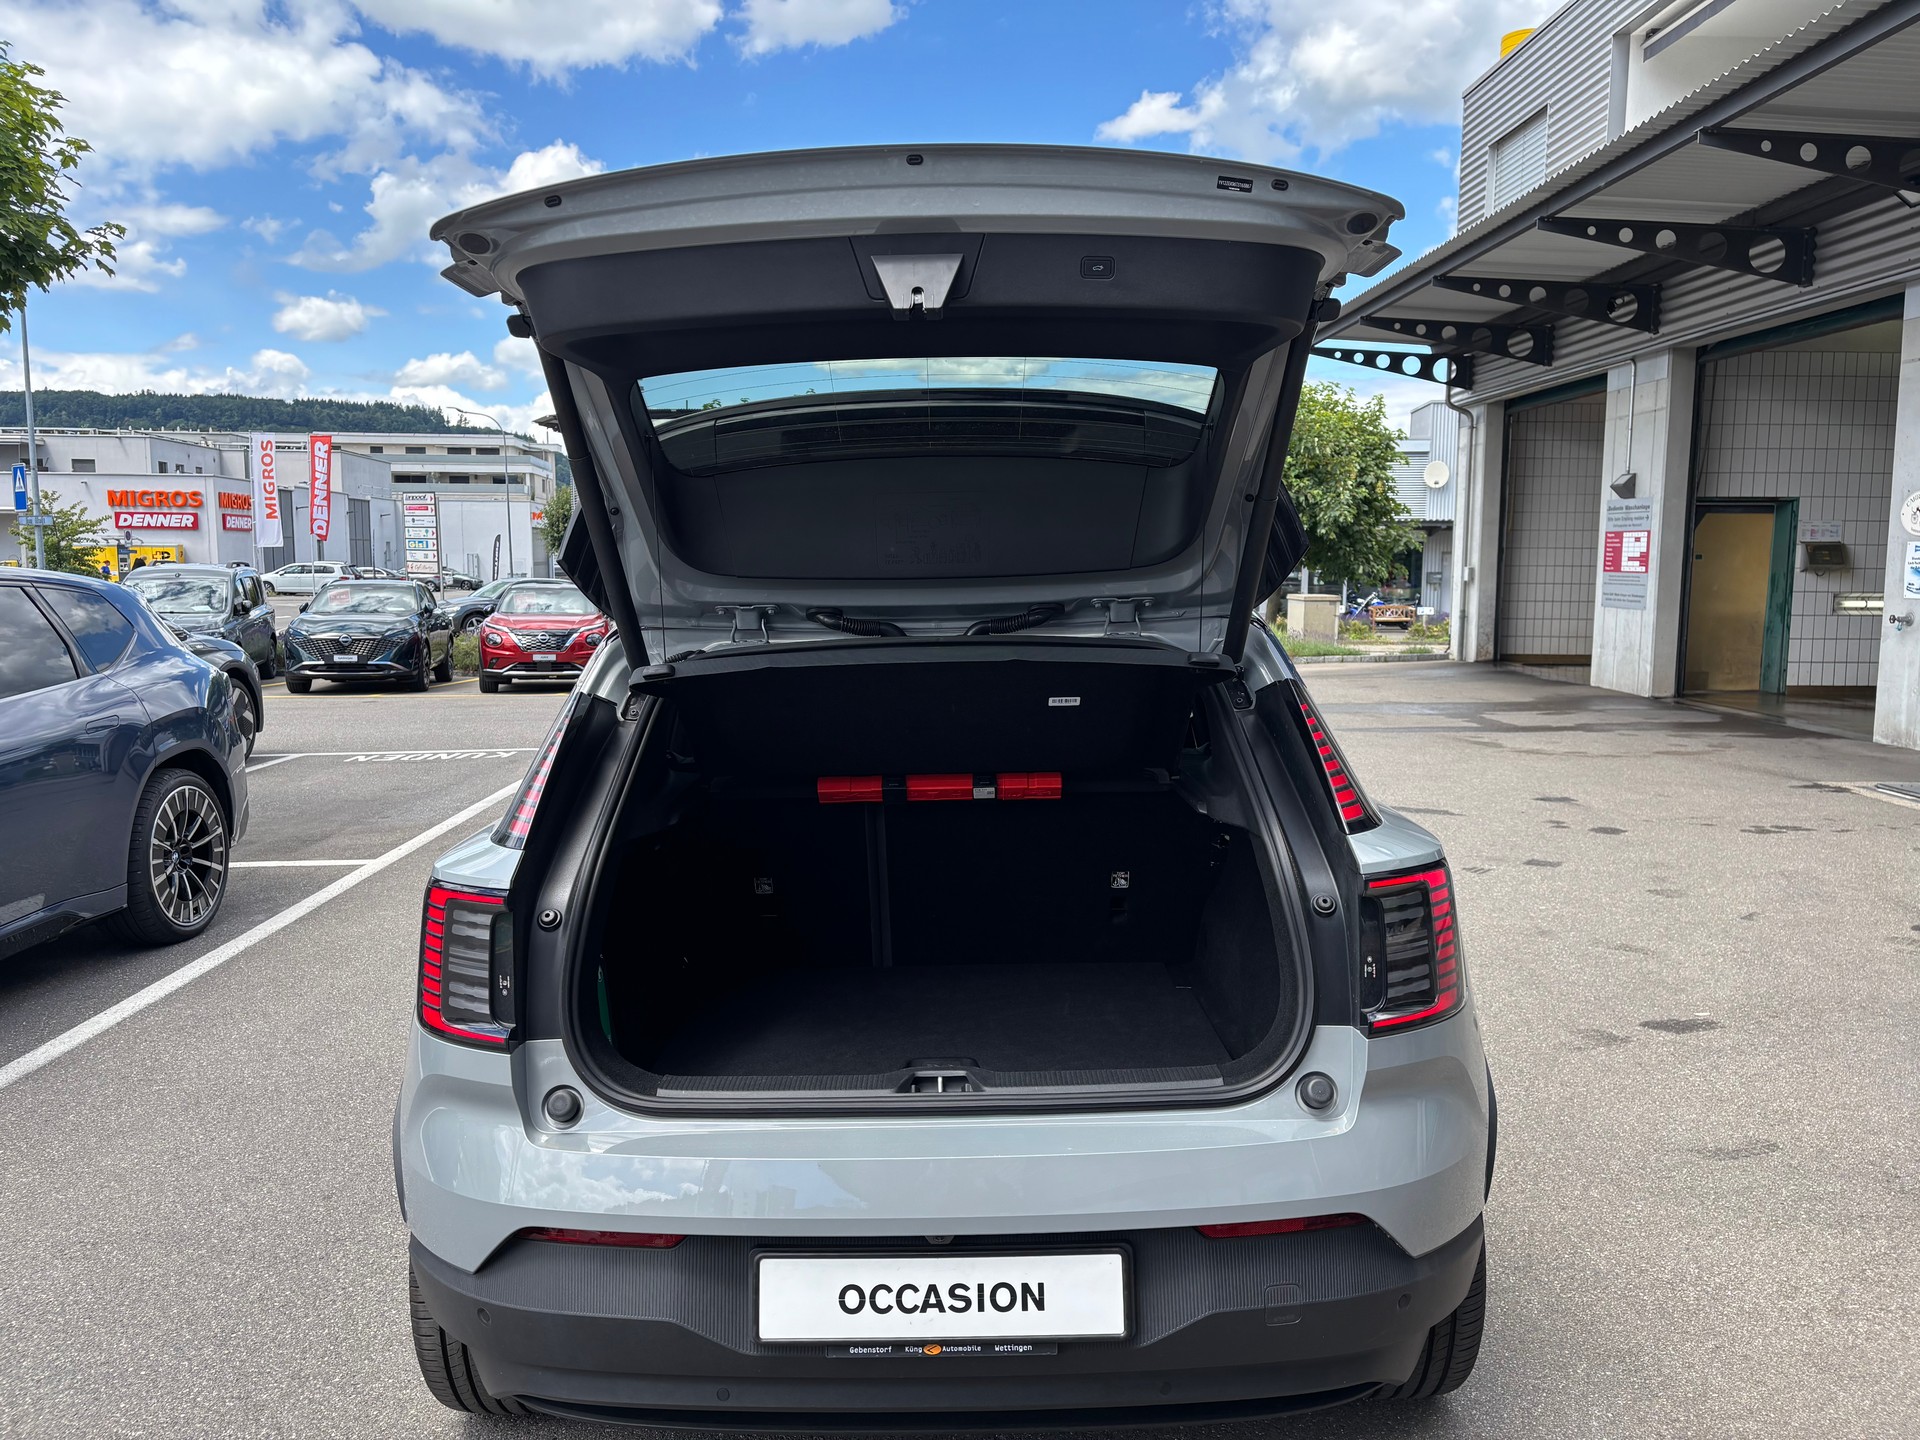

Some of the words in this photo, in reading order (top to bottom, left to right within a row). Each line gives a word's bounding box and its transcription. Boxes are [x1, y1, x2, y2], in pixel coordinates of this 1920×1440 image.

[260, 439, 279, 520] MIGROS
[312, 441, 329, 536] DENNER
[107, 489, 203, 508] MIGROS
[118, 513, 195, 528] DENNER
[226, 515, 252, 529] DENNER
[343, 751, 517, 762] KUNDEN
[838, 1281, 1045, 1315] OCCASION
[849, 1346, 892, 1354] Gebenstorf
[904, 1346, 923, 1354] Küng
[994, 1344, 1033, 1352] Wettingen
